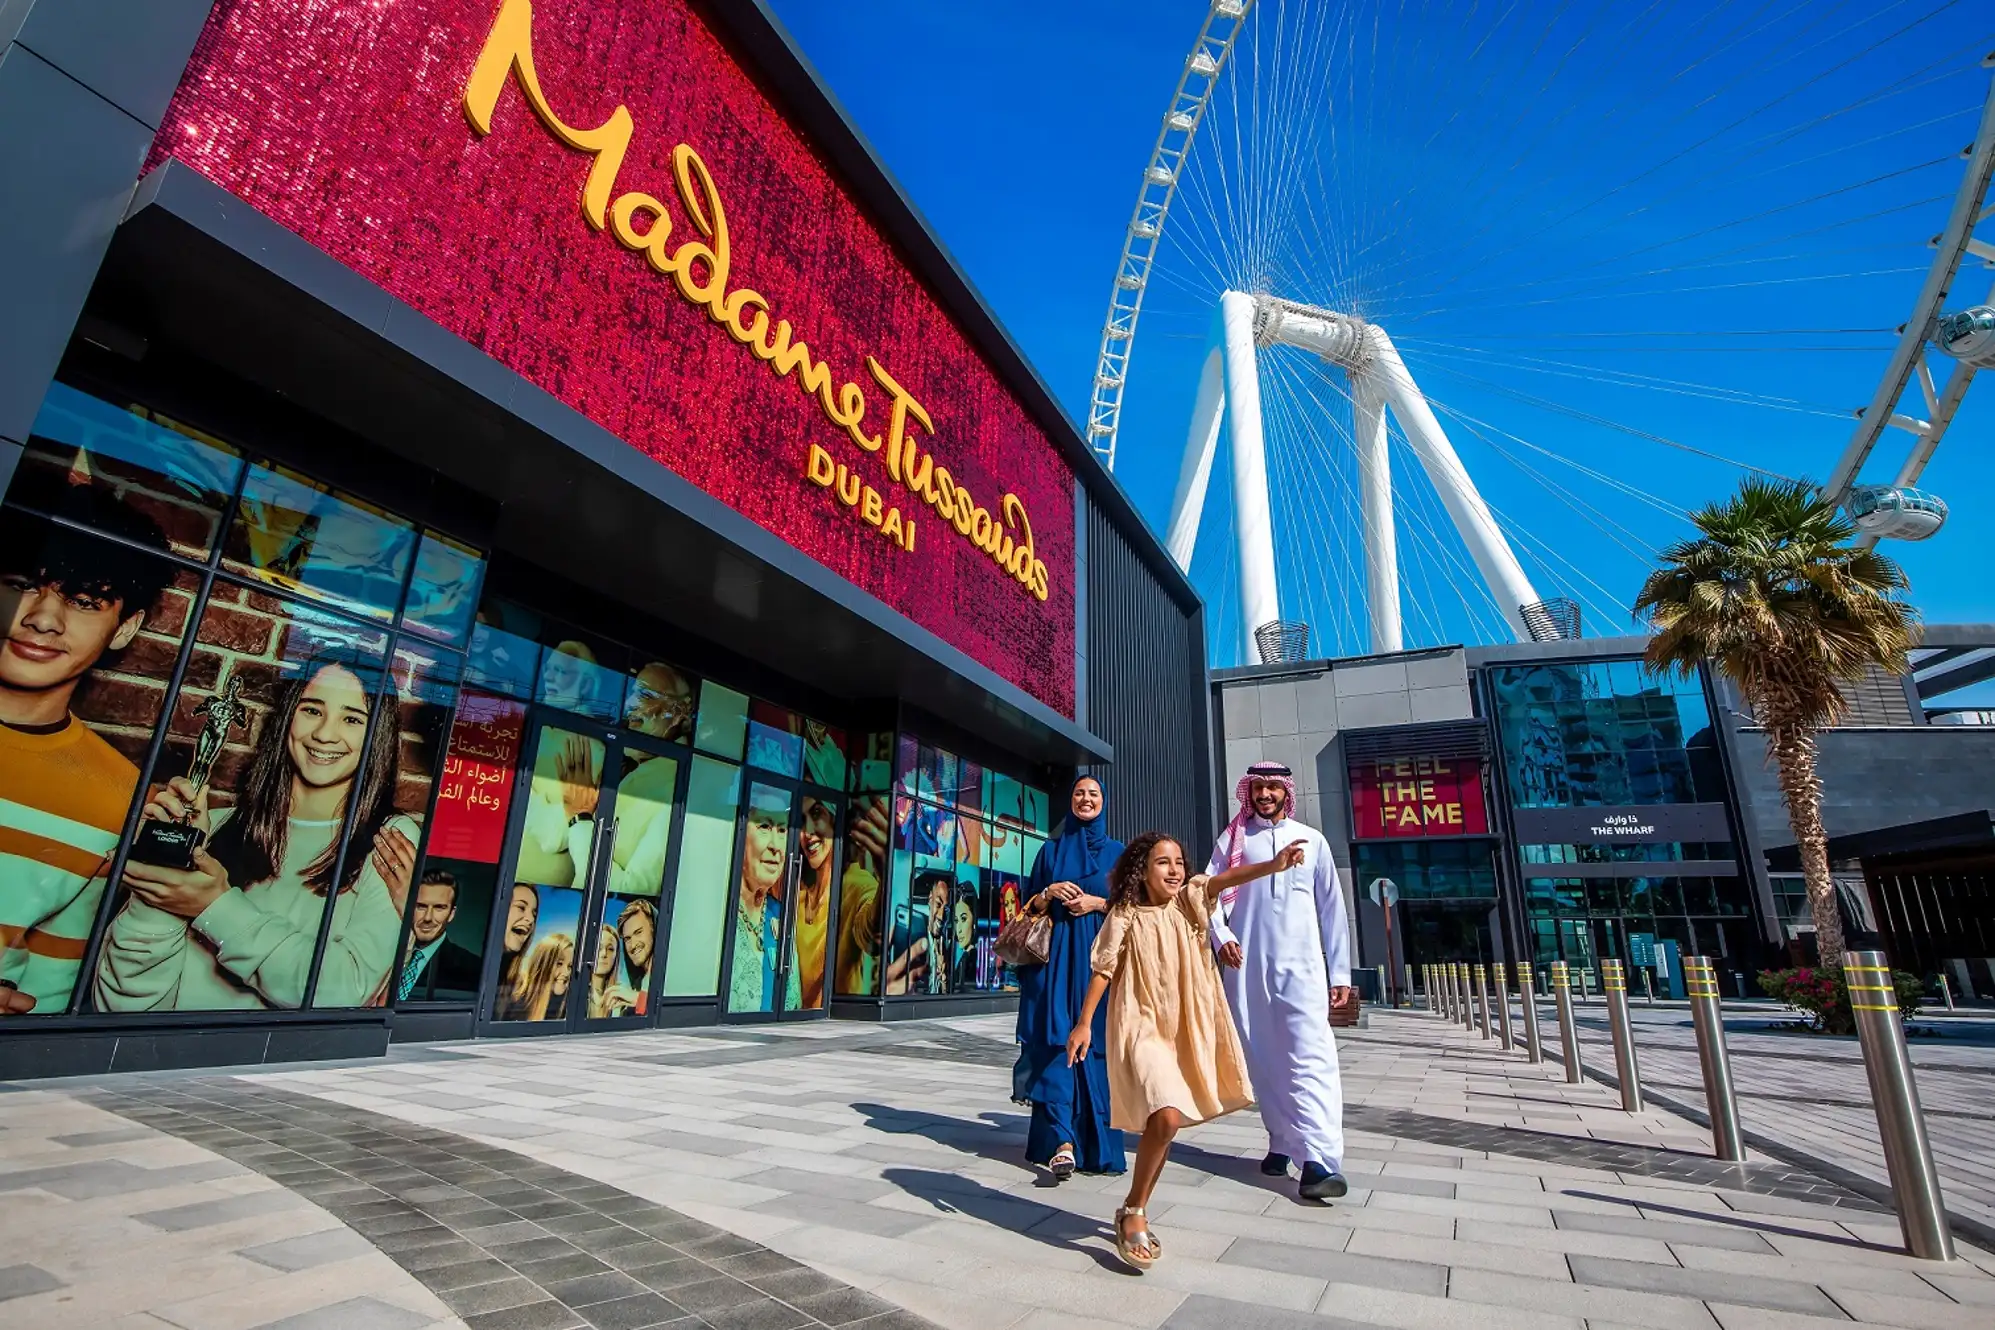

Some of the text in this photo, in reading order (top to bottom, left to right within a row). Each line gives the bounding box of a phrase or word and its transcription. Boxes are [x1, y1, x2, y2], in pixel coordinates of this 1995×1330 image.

[463, 0, 1049, 602] Madame Tussauds
[807, 443, 917, 552] DUBAI
[480, 717, 519, 742] تجربة
[448, 735, 511, 761] للاستمتاع
[467, 764, 507, 785] أضواء
[1374, 755, 1451, 778] FEEL
[466, 785, 500, 811] وعالم
[1377, 779, 1437, 803] THE
[1380, 802, 1464, 827] FAME
[1627, 814, 1639, 823] ذا
[1590, 825, 1655, 836] THE WHARF
